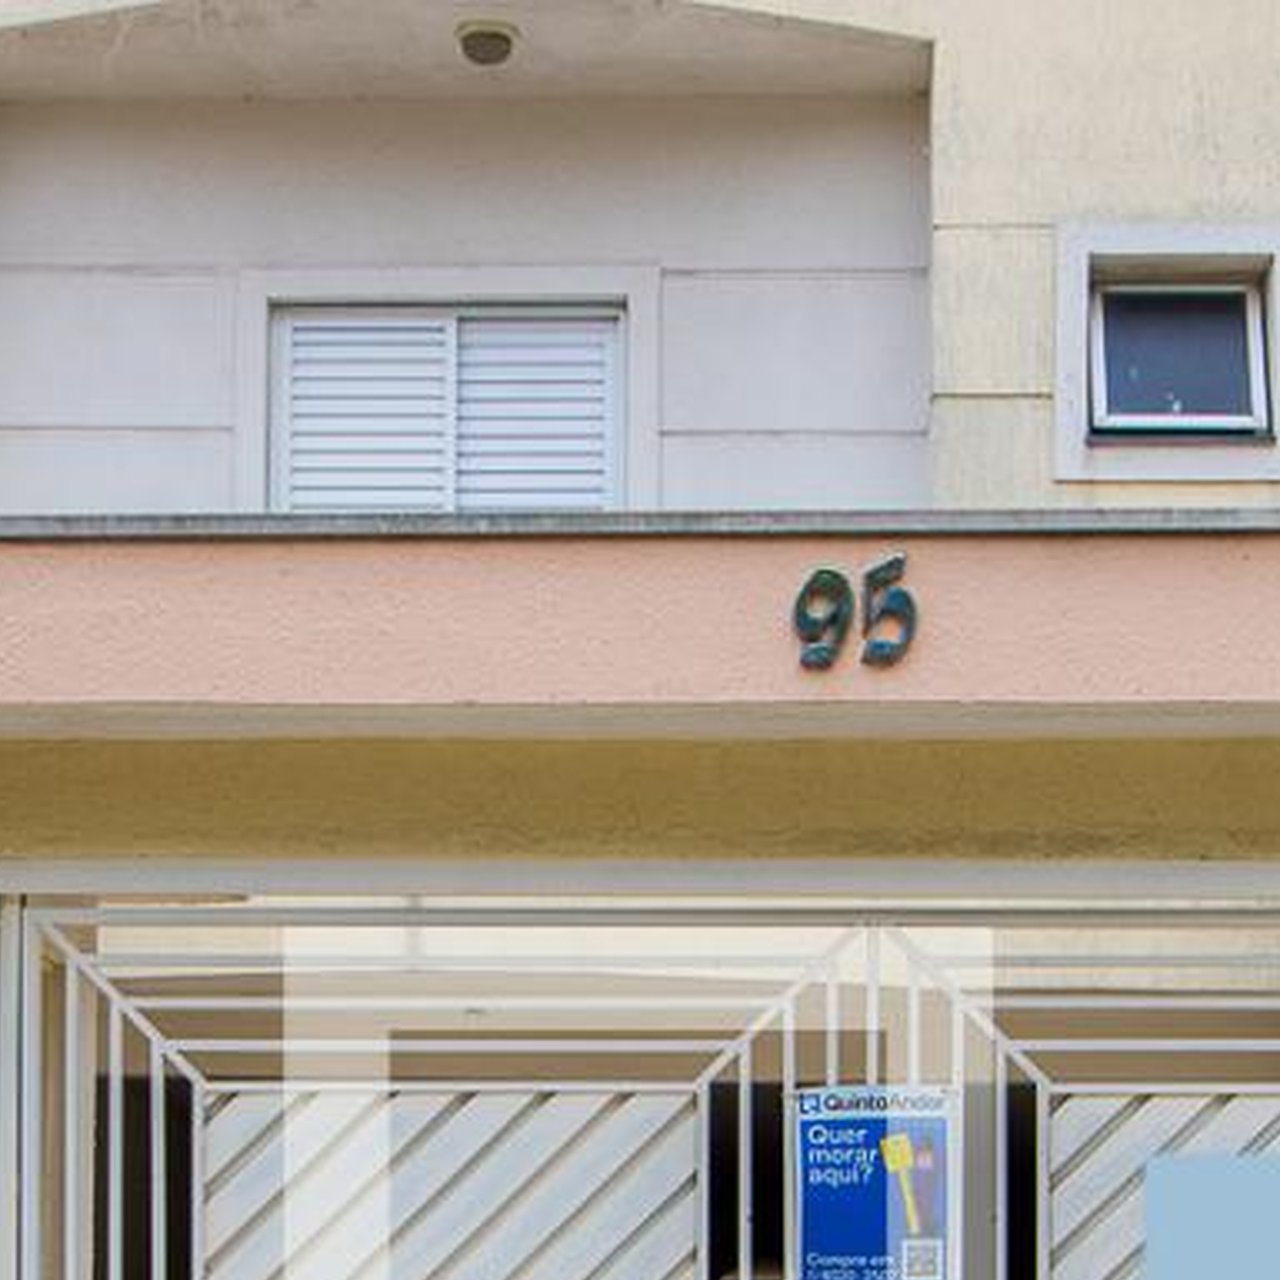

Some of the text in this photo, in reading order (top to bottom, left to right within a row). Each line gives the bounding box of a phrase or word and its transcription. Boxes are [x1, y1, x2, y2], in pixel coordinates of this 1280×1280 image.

[795, 552, 917, 669] 95
[808, 1124, 867, 1145] Quer
[808, 1149, 877, 1164] morar
[809, 1163, 873, 1188] aqui?
